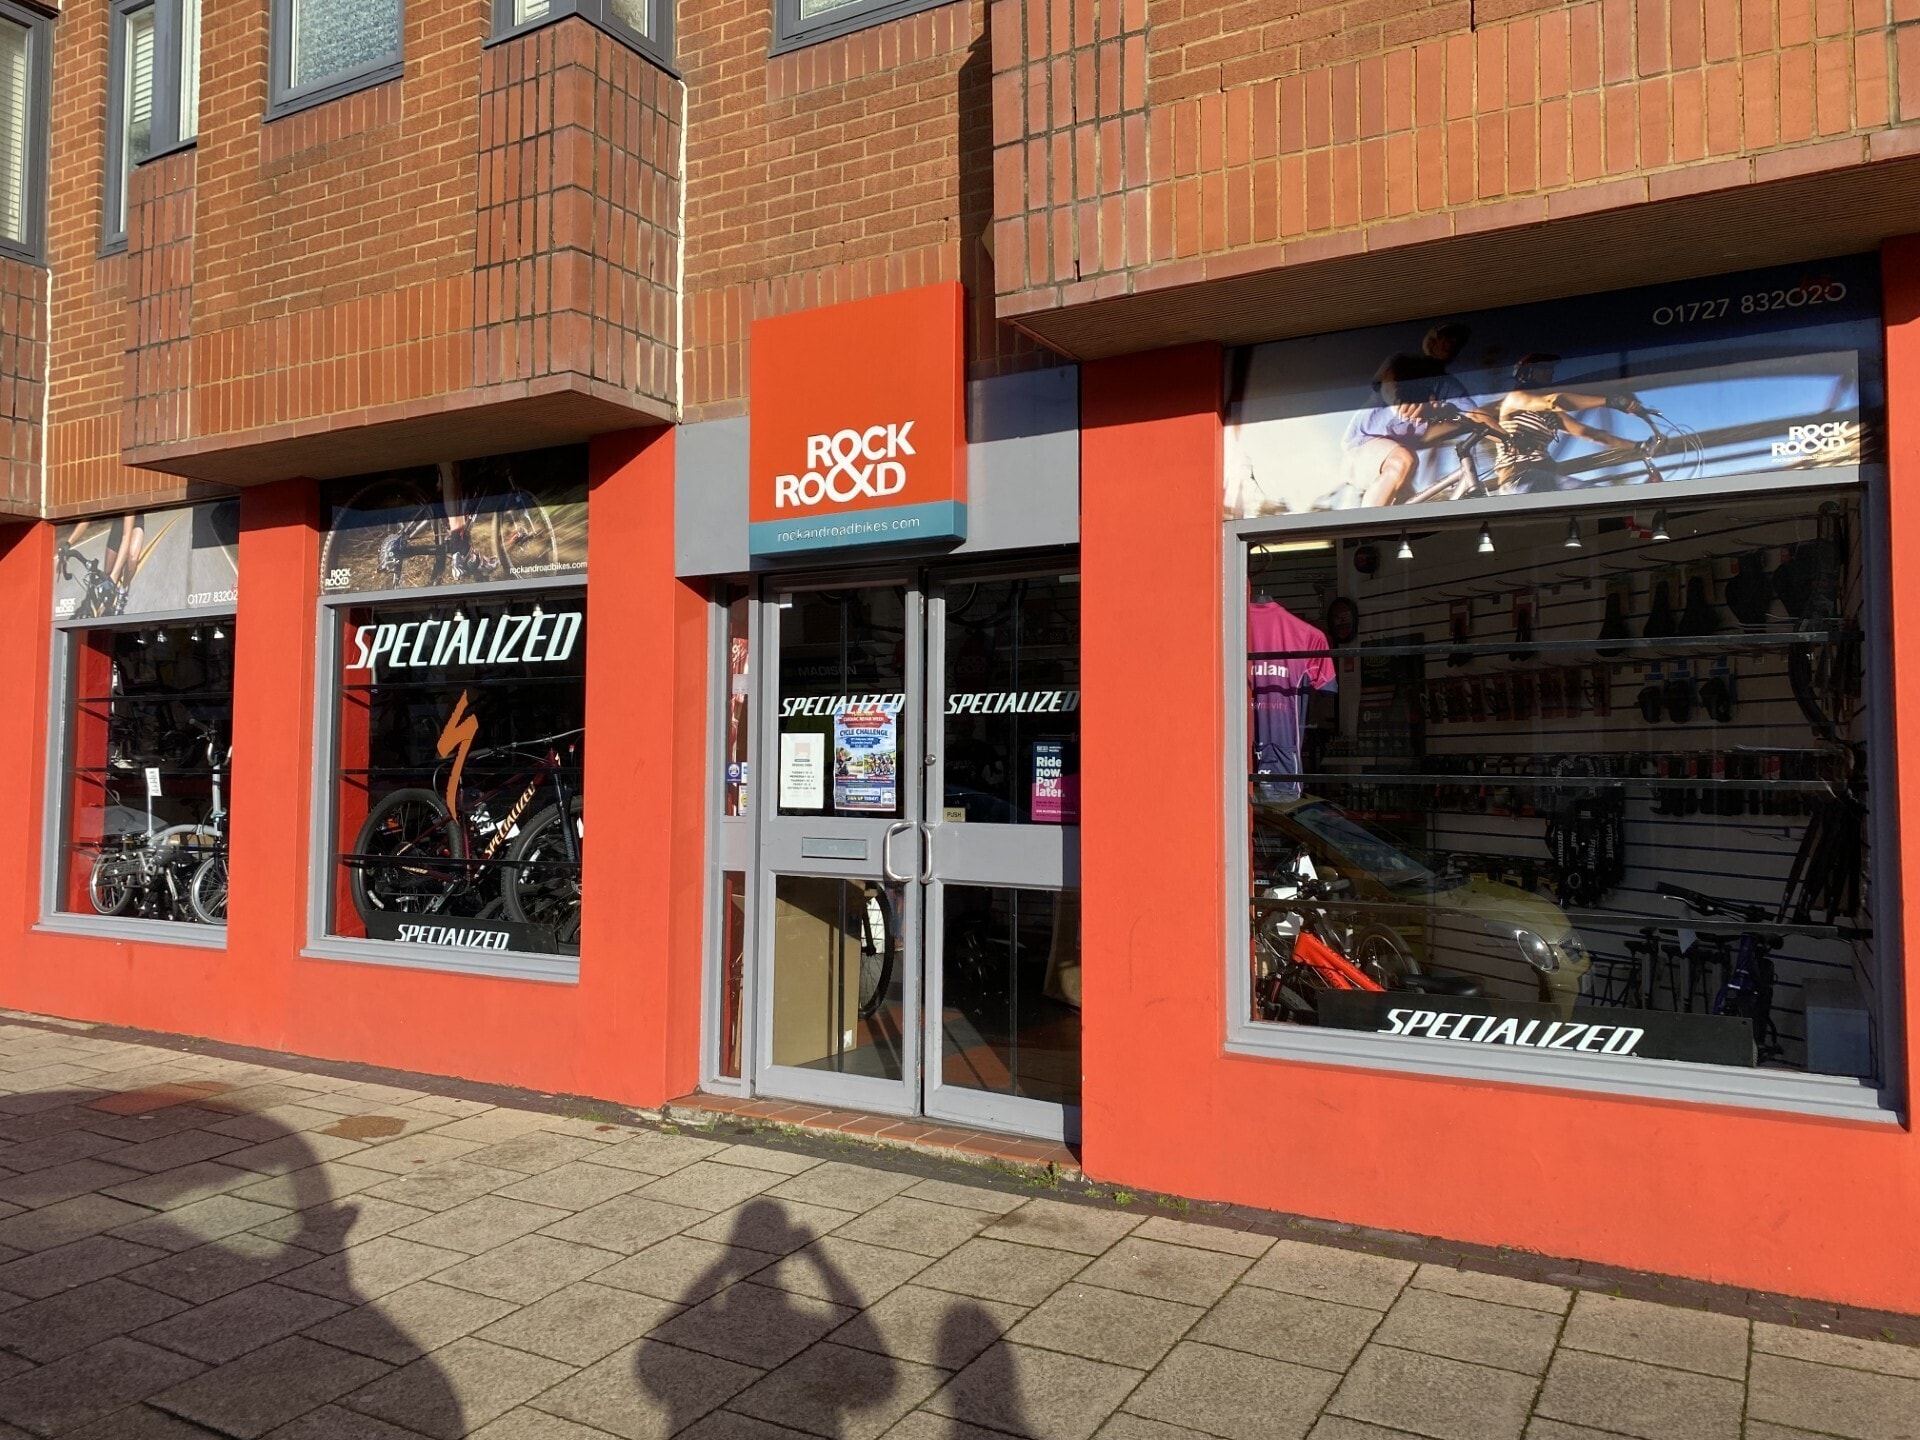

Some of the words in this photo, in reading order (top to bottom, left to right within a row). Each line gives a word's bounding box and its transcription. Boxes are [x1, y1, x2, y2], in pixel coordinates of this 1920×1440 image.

[1652, 298, 1730, 326] 01727
[1740, 282, 1847, 314] 832020
[1788, 420, 1850, 441] ROCK
[807, 420, 916, 469] ROCK
[330, 568, 351, 578] ROCK
[187, 592, 211, 604] 01727
[345, 611, 583, 669] SPECIALIZED
[798, 663, 857, 677] MADISN
[778, 693, 906, 717] SPECIALIZED
[944, 690, 1081, 715] SPECIALIZED
[840, 728, 855, 737] CYCLE
[855, 728, 888, 736] CHALLENGE
[1036, 755, 1062, 768] Ride
[1035, 767, 1063, 778] now.
[1035, 776, 1058, 789] Pay
[1035, 783, 1066, 798] later.
[484, 780, 536, 860] SPECIALIZED
[394, 923, 510, 951] SPECIALIZED
[1377, 1008, 1645, 1056] SPECIALIZED
